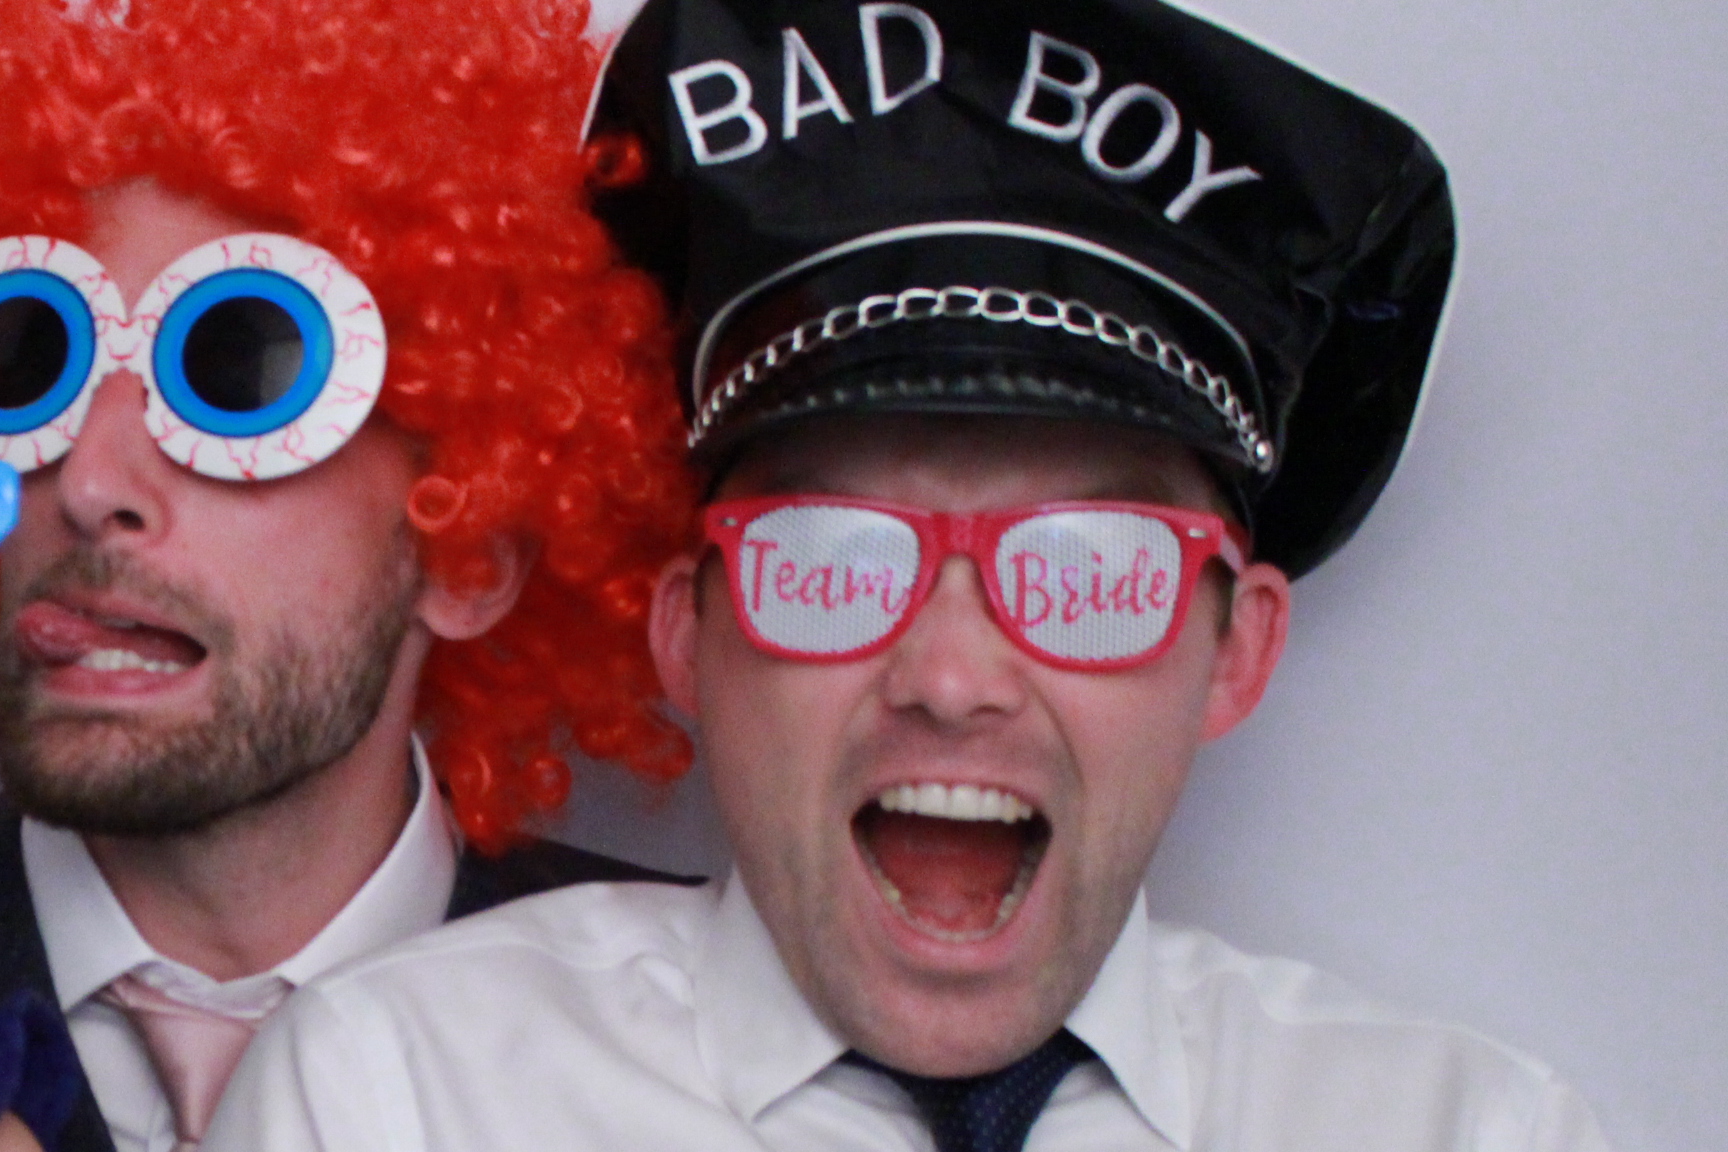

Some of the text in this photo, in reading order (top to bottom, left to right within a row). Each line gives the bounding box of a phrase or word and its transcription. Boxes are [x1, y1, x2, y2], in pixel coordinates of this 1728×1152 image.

[669, 3, 1261, 223] BAD BOY
[744, 540, 1175, 628] Team Bride
